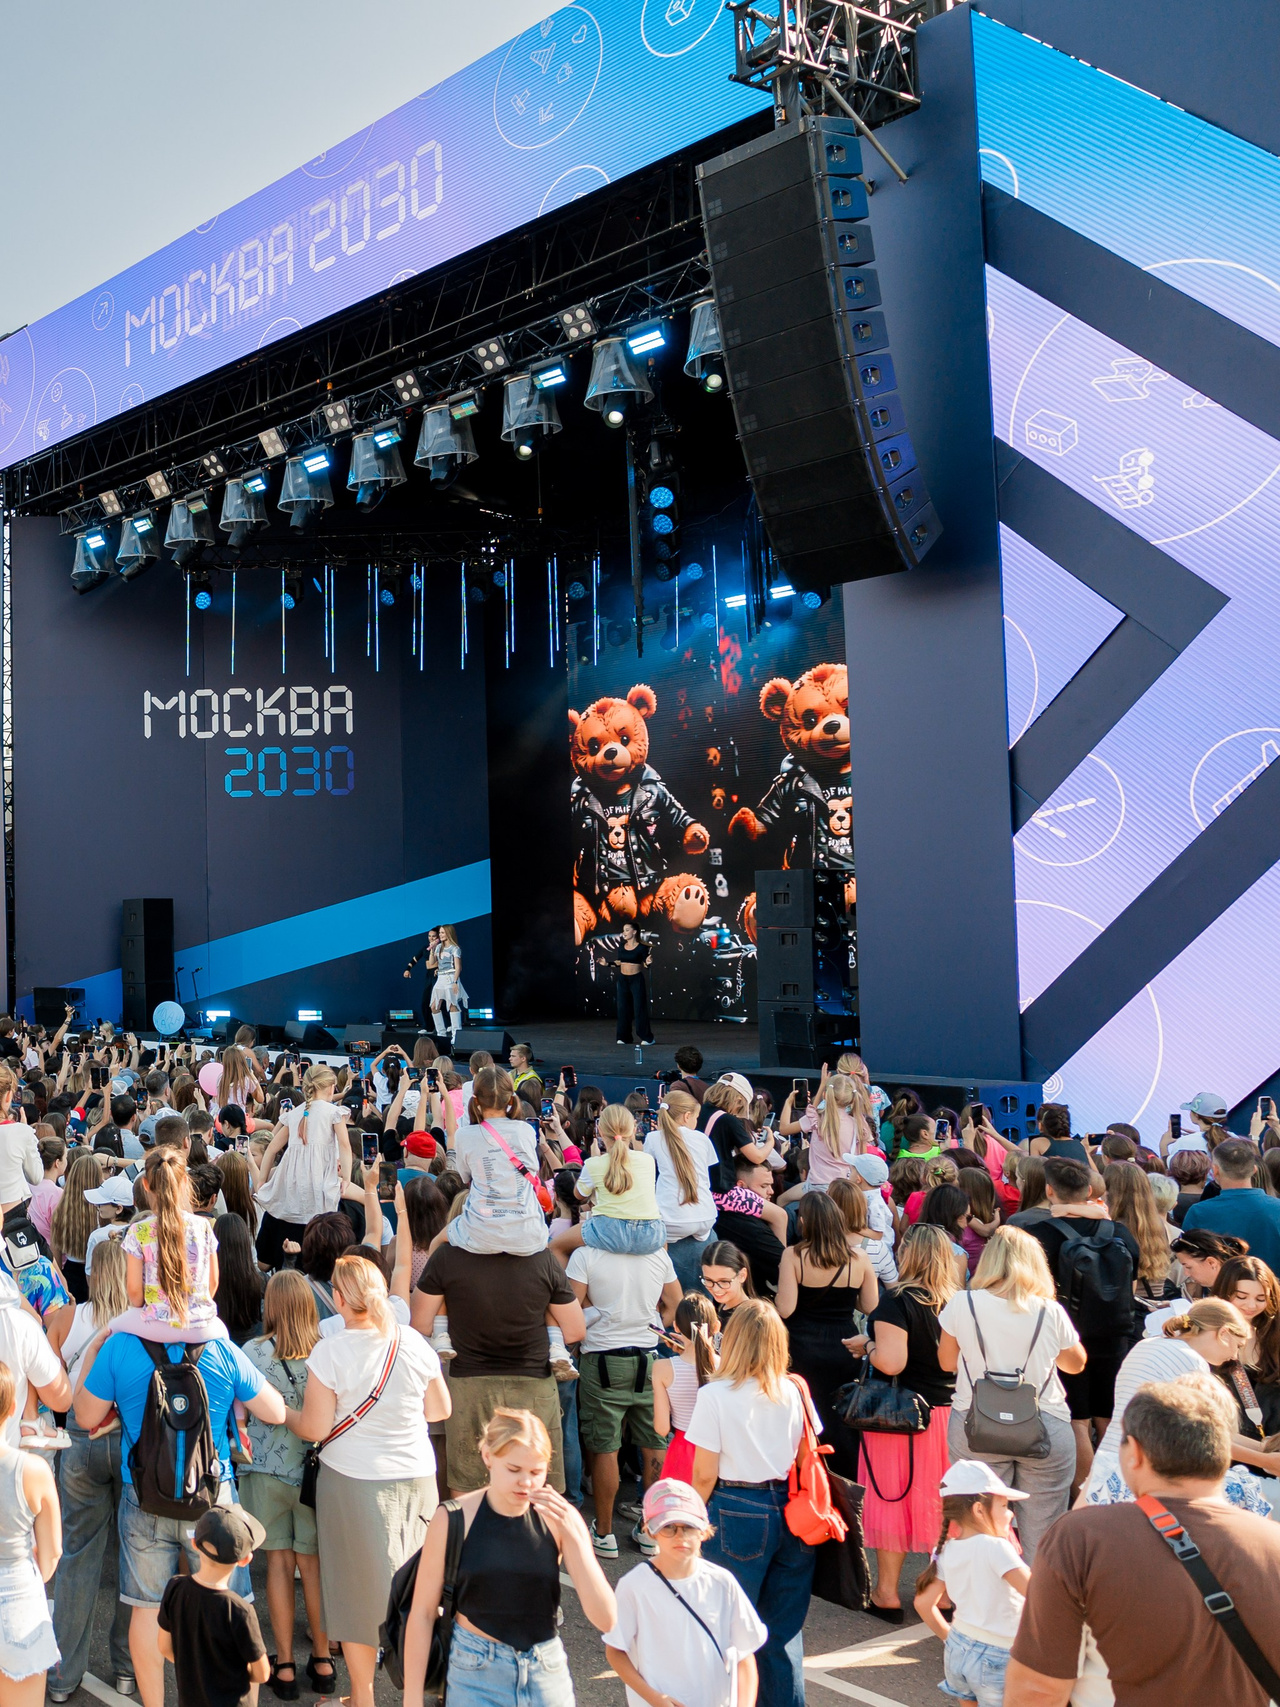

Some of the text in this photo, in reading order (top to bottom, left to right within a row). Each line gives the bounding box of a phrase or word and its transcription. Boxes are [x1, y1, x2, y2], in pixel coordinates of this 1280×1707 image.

[125, 139, 443, 368] МОСКВА 2030
[143, 685, 354, 739] МОСКВА
[224, 745, 355, 798] 2030
